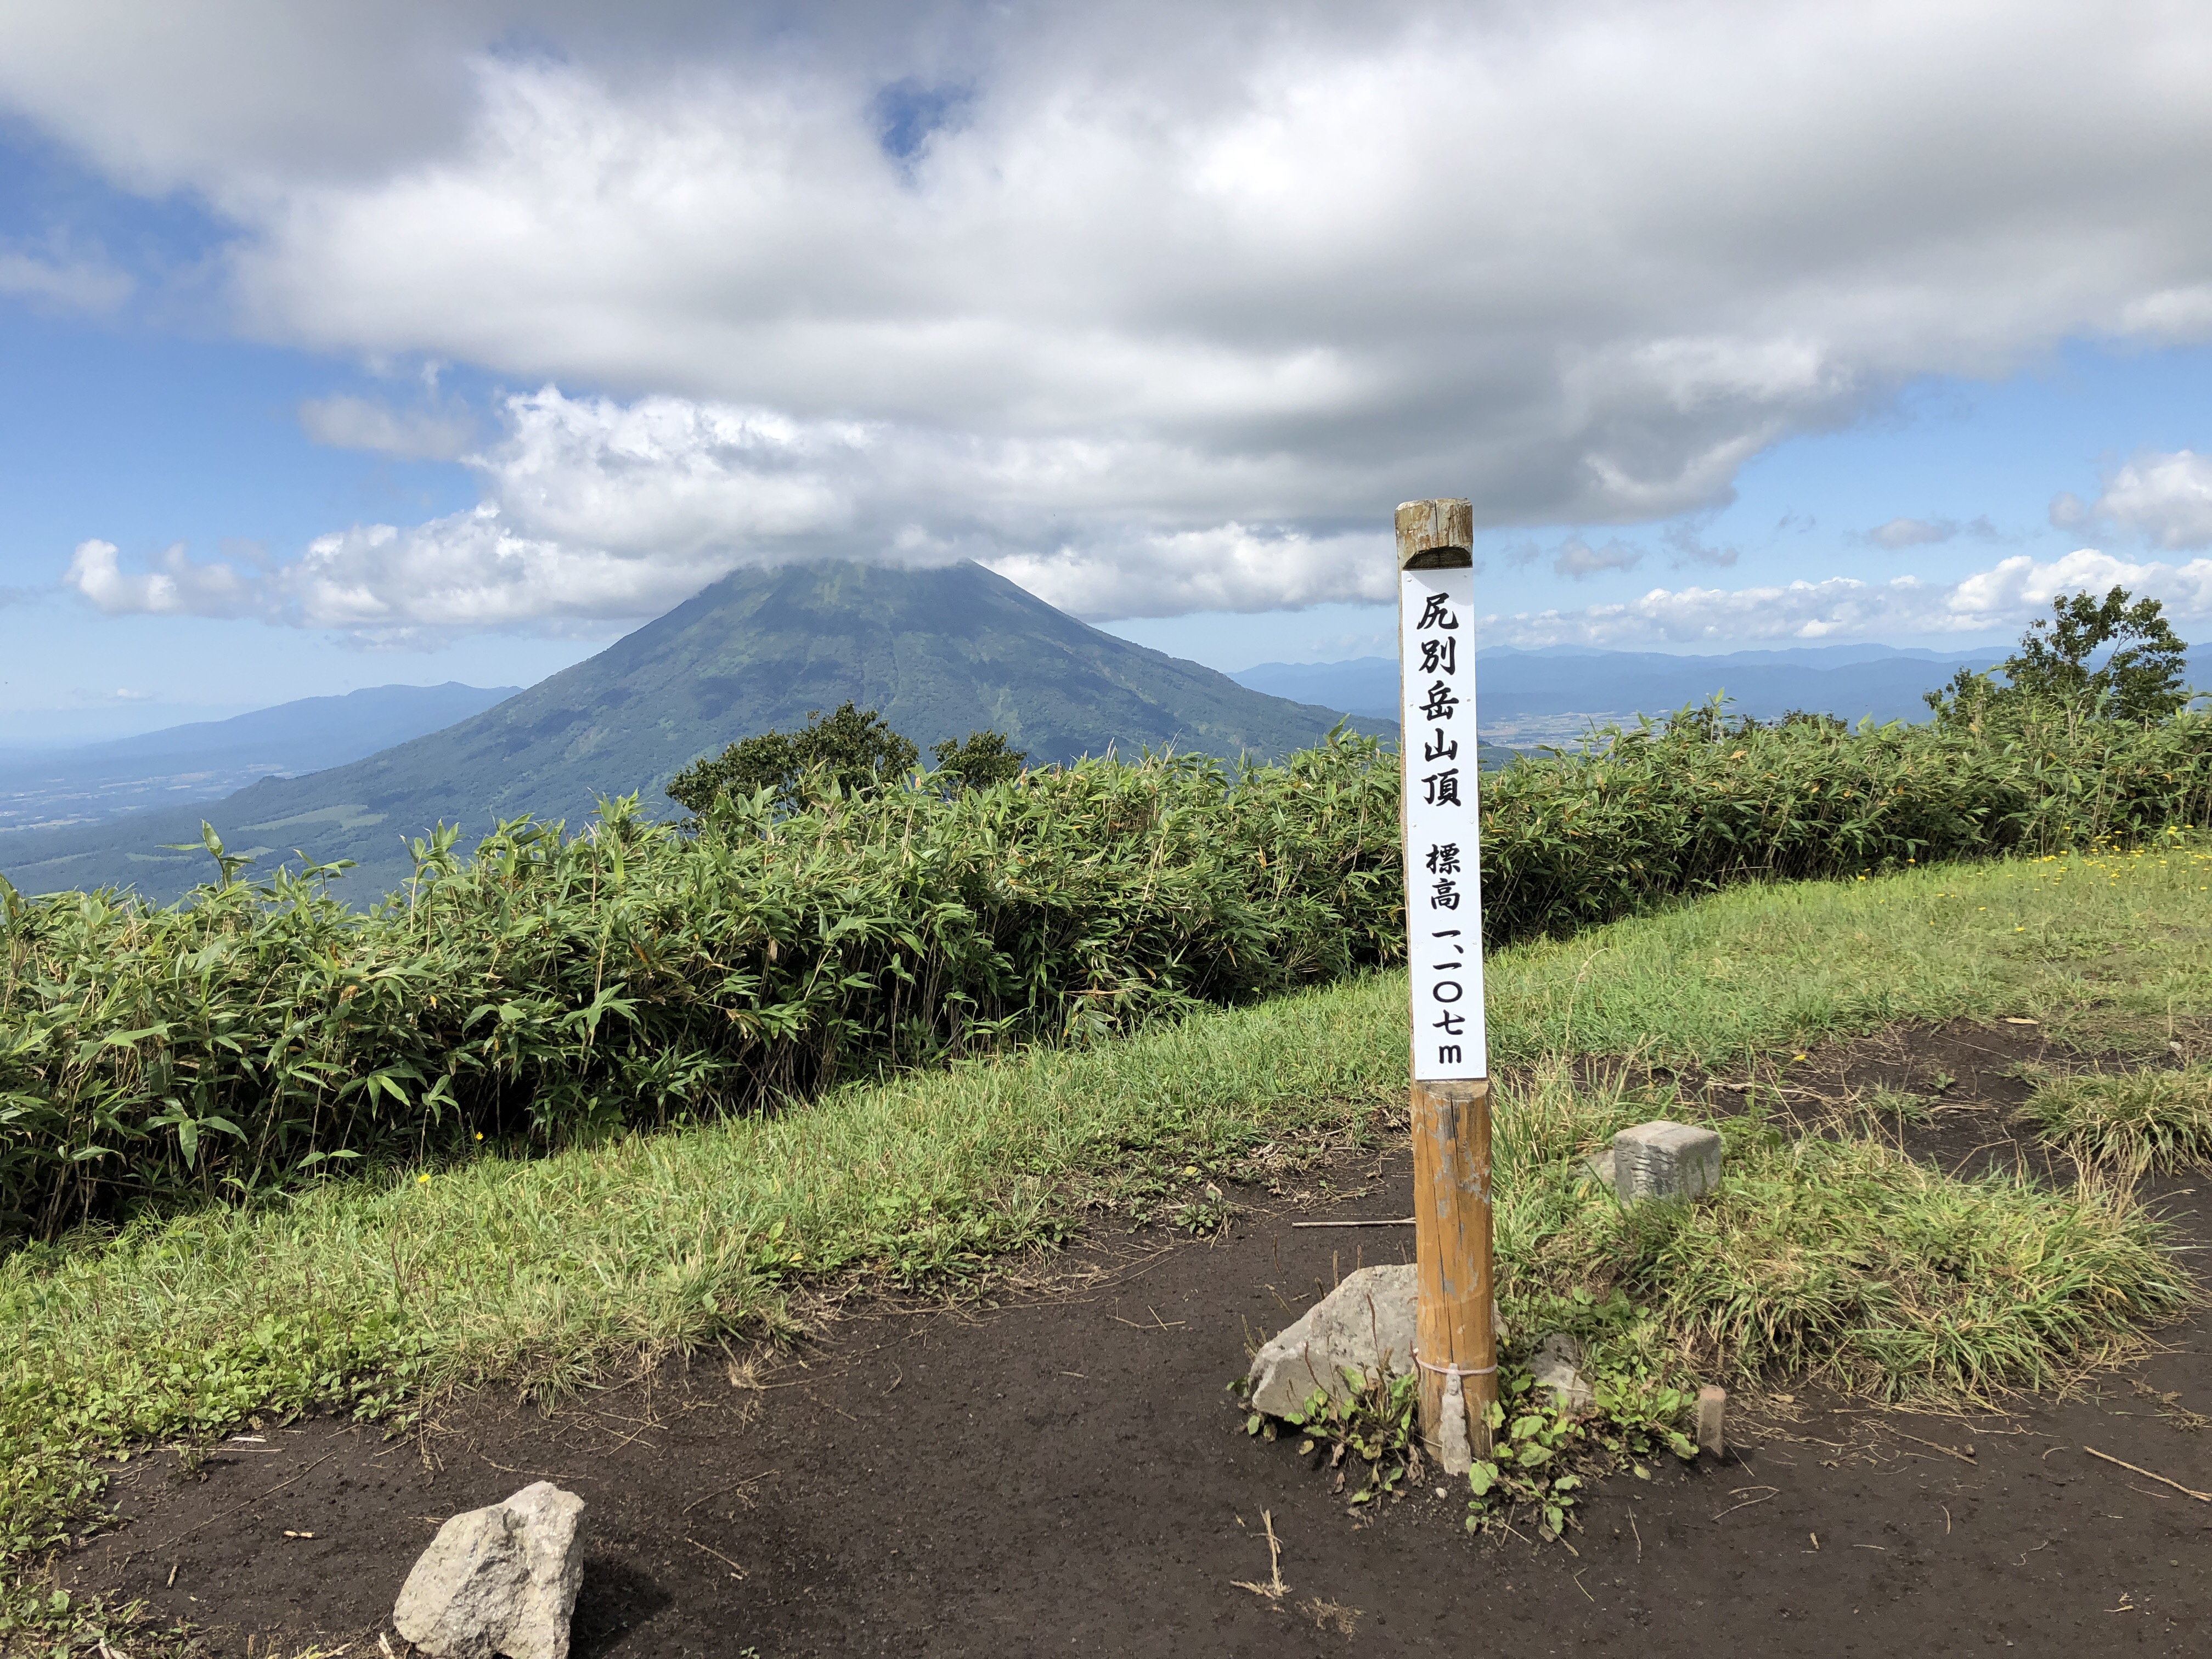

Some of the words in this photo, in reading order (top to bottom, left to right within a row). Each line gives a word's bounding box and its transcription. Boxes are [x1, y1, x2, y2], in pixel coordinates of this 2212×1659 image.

[1417, 592, 1462, 806] 尻別岳山頂
